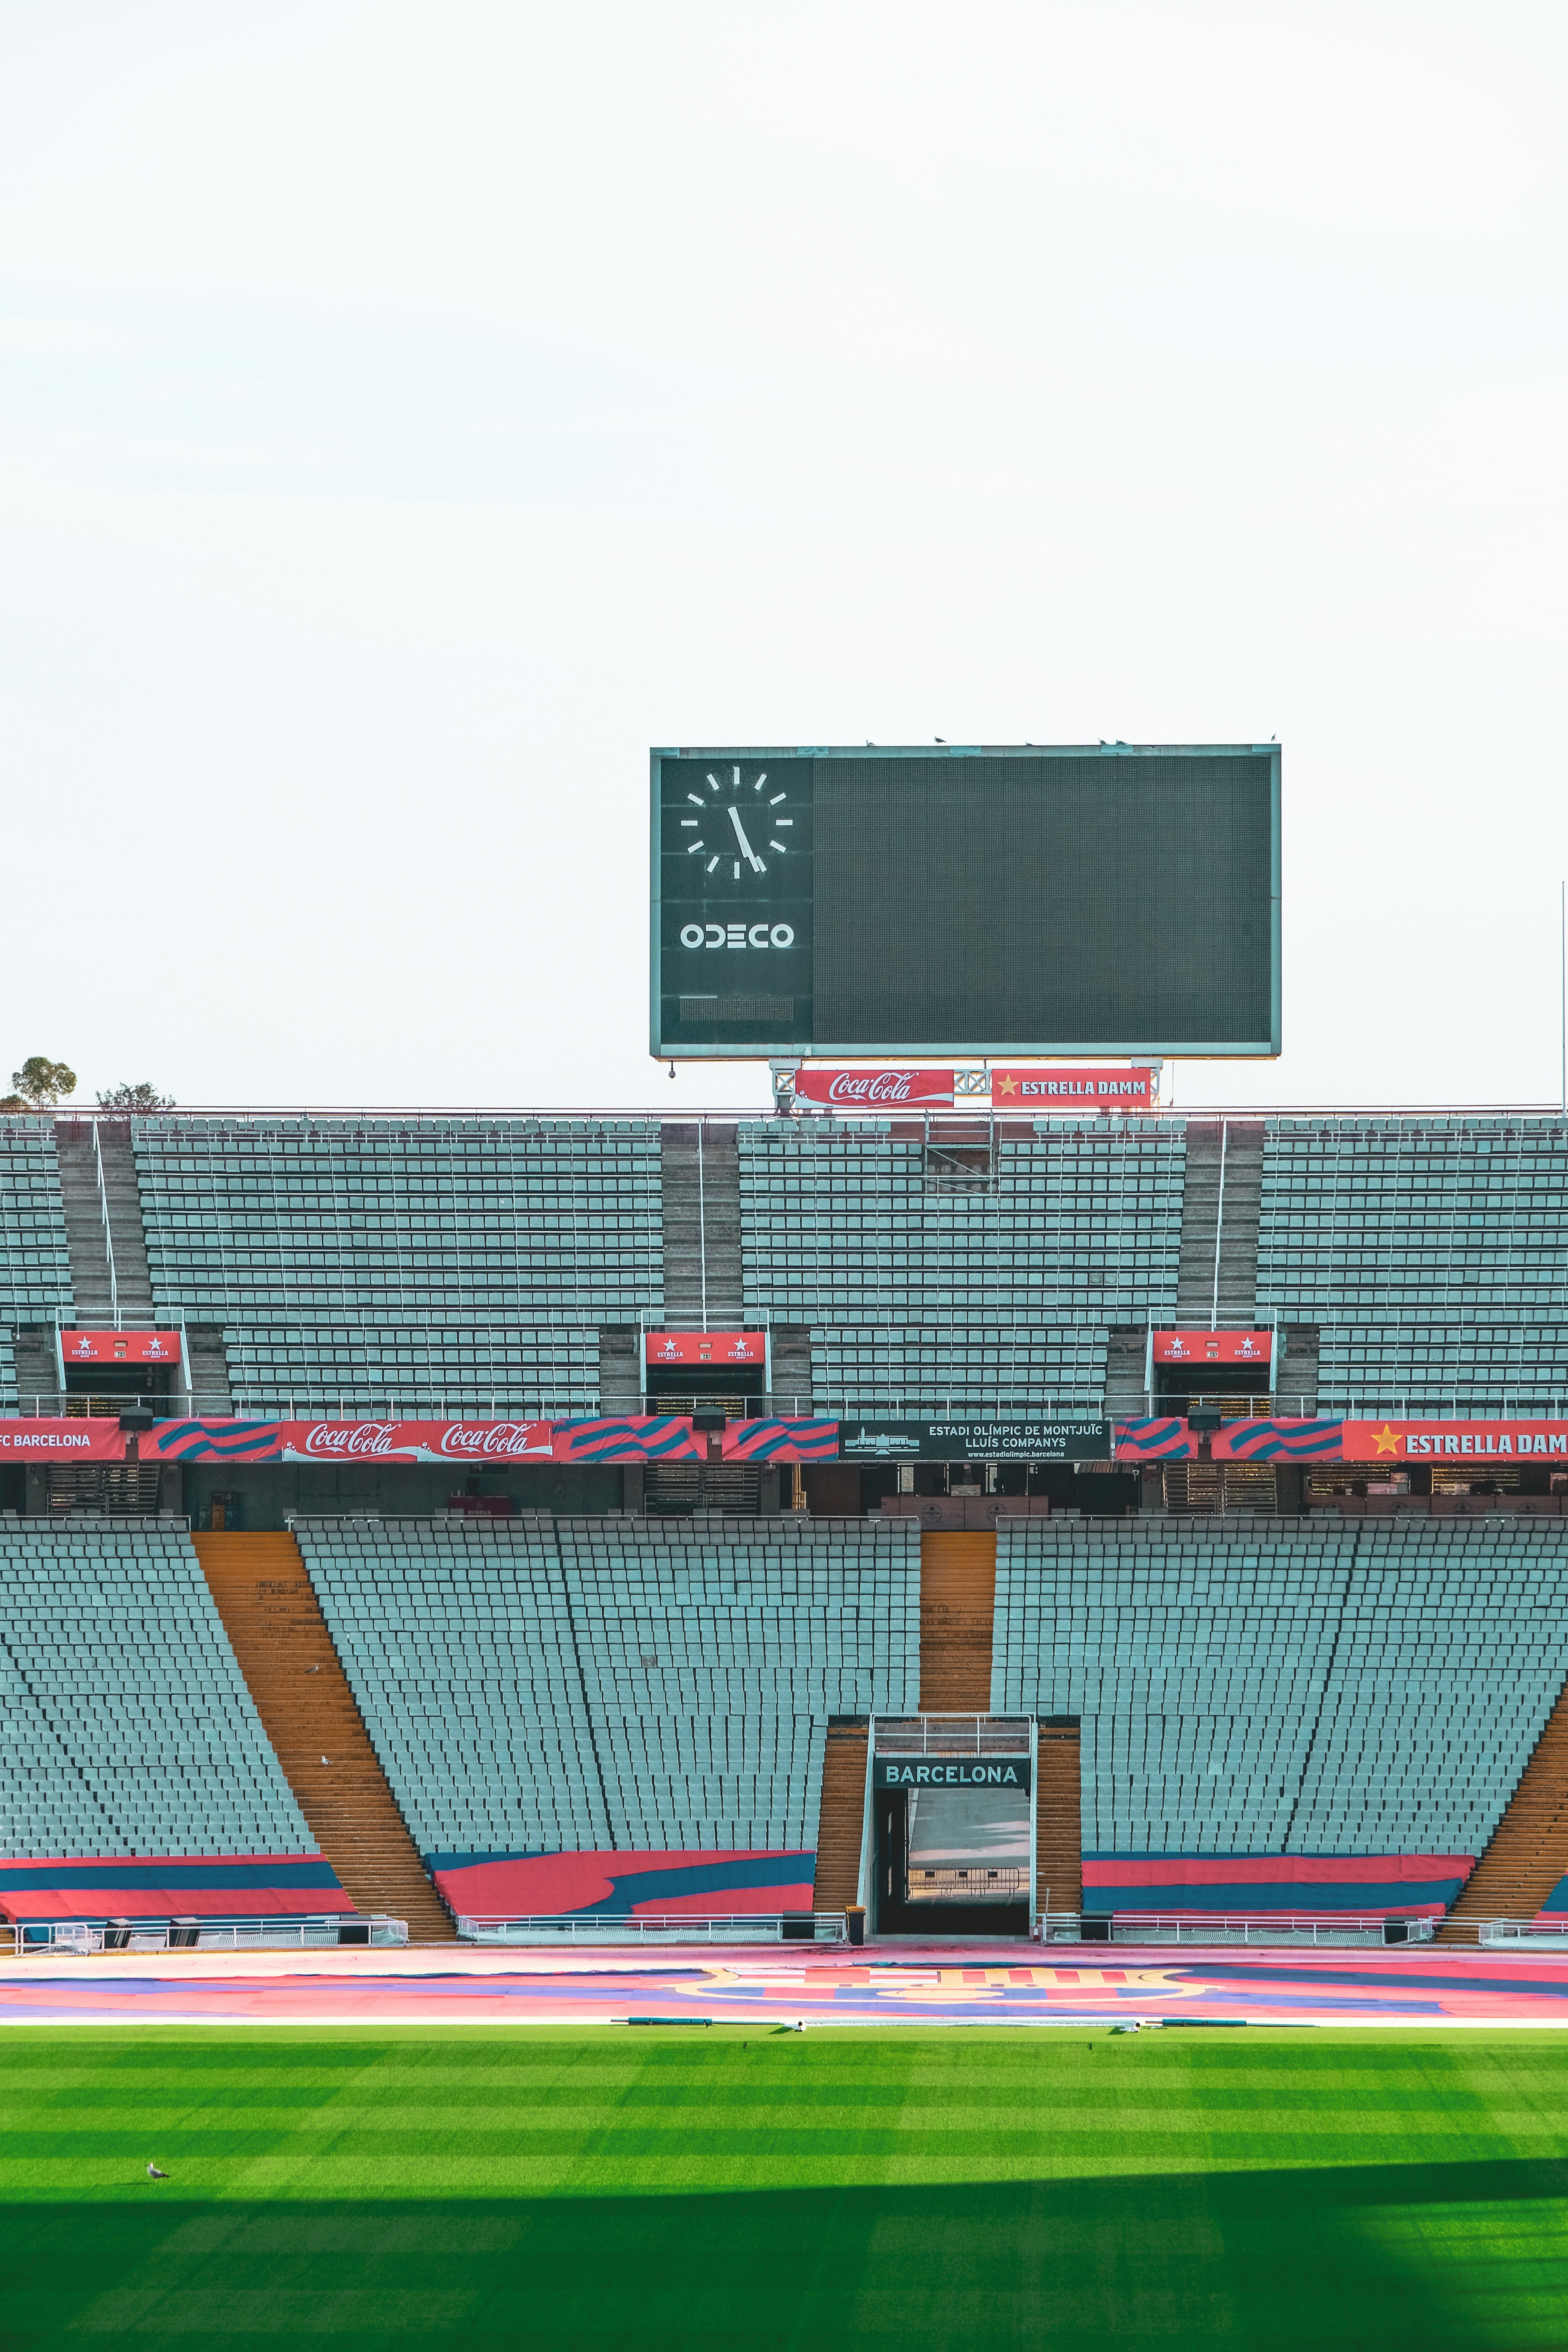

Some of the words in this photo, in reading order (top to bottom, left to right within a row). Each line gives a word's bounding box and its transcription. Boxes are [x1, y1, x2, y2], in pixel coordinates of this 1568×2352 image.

[680, 923, 794, 948] ODECO
[829, 1072, 916, 1100] Coca-Cola
[1021, 1081, 1095, 1095] ESTRELLA
[1097, 1081, 1145, 1095] DAMM
[306, 1423, 398, 1453] Coca-Cola
[441, 1423, 533, 1453] Coca-Cola
[929, 1426, 969, 1436] ESTADI
[973, 1424, 1021, 1436] OLÍMPIC
[1025, 1426, 1040, 1435] DE
[1043, 1424, 1103, 1435] MONTJUÏC
[14, 1435, 90, 1446] BARCELONA
[966, 1436, 999, 1447] LLUÍS
[1002, 1438, 1066, 1447] COMPANYS
[1406, 1435, 1513, 1453] ESTRELLA
[1517, 1435, 1568, 1453] DAM
[886, 1766, 1018, 1782] BARCELONA
